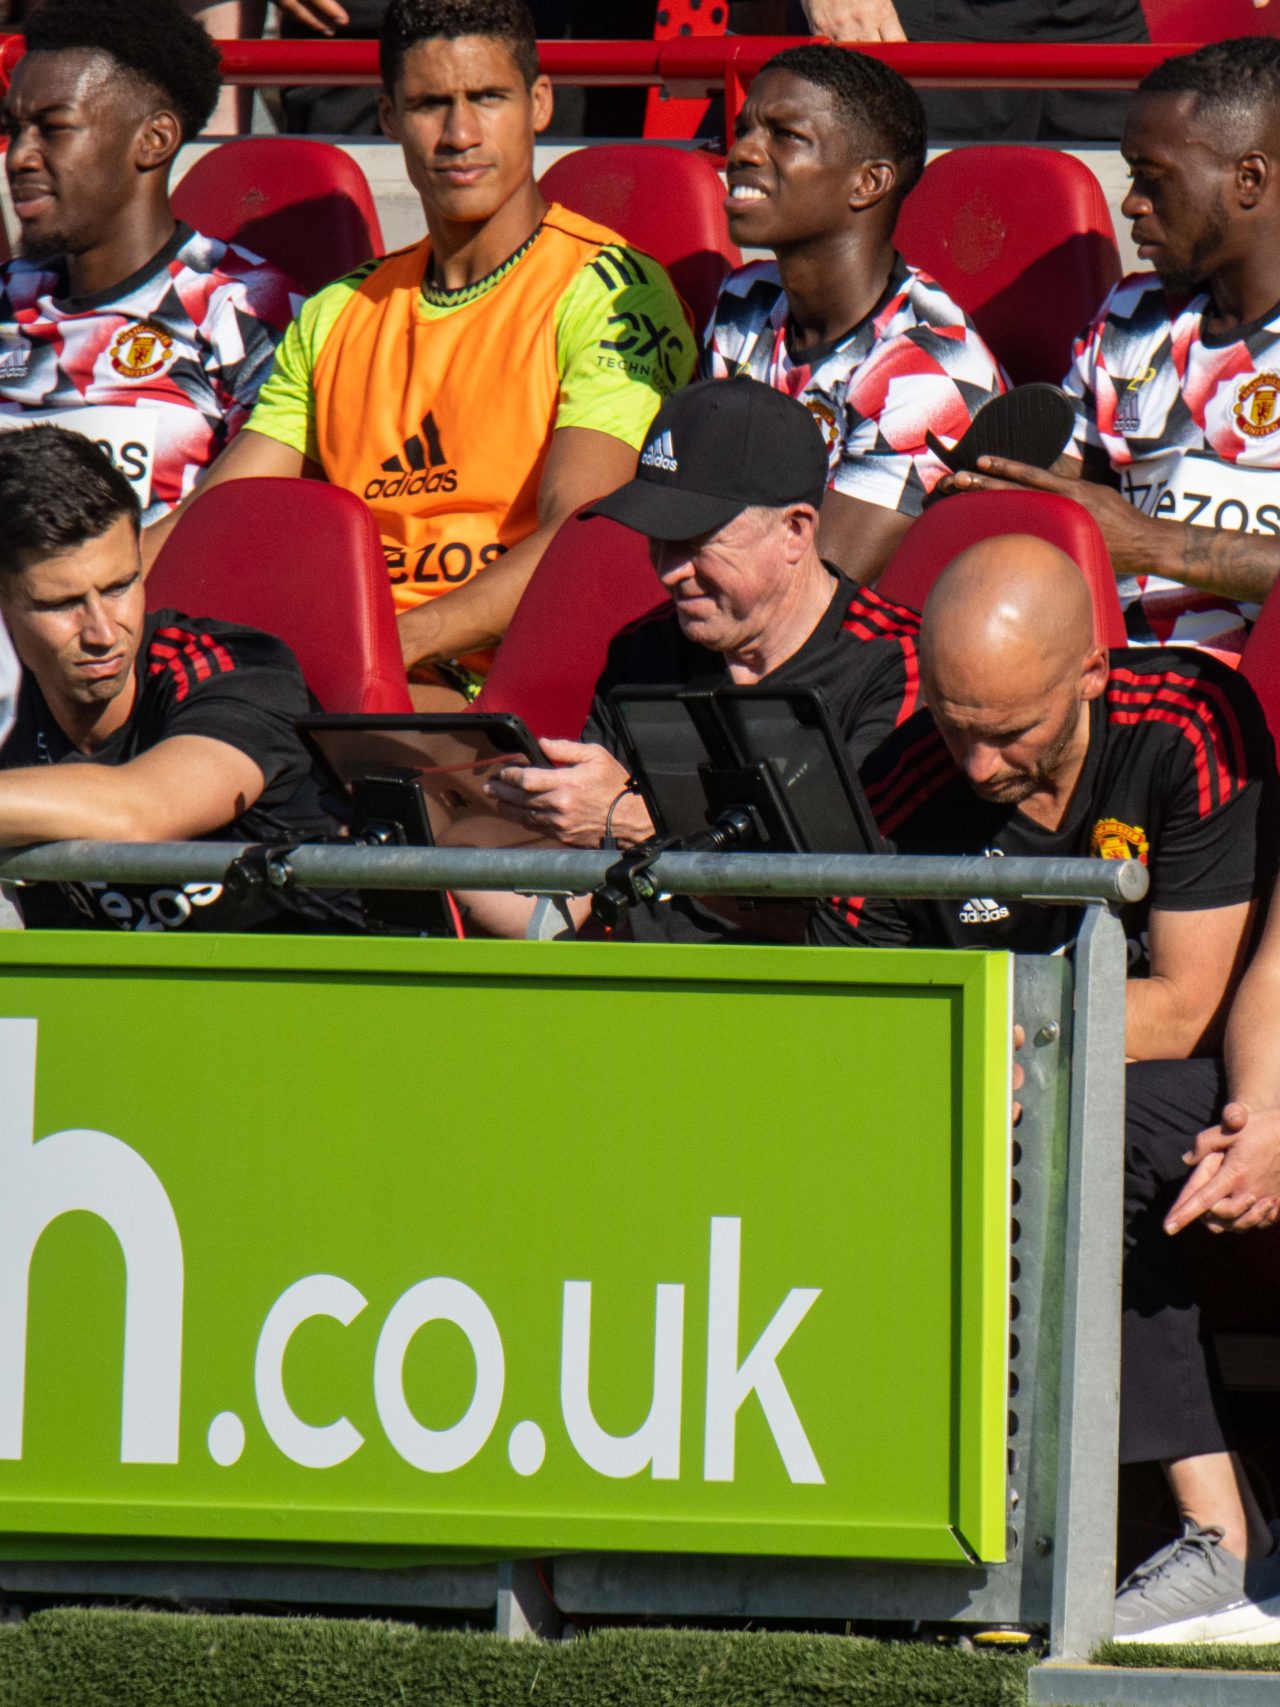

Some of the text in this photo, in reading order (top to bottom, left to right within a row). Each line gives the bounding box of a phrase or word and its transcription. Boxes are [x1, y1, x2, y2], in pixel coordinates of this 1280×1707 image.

[1242, 422, 1279, 437] UNITED
[364, 468, 458, 500] adidas
[959, 904, 1010, 924] adidas
